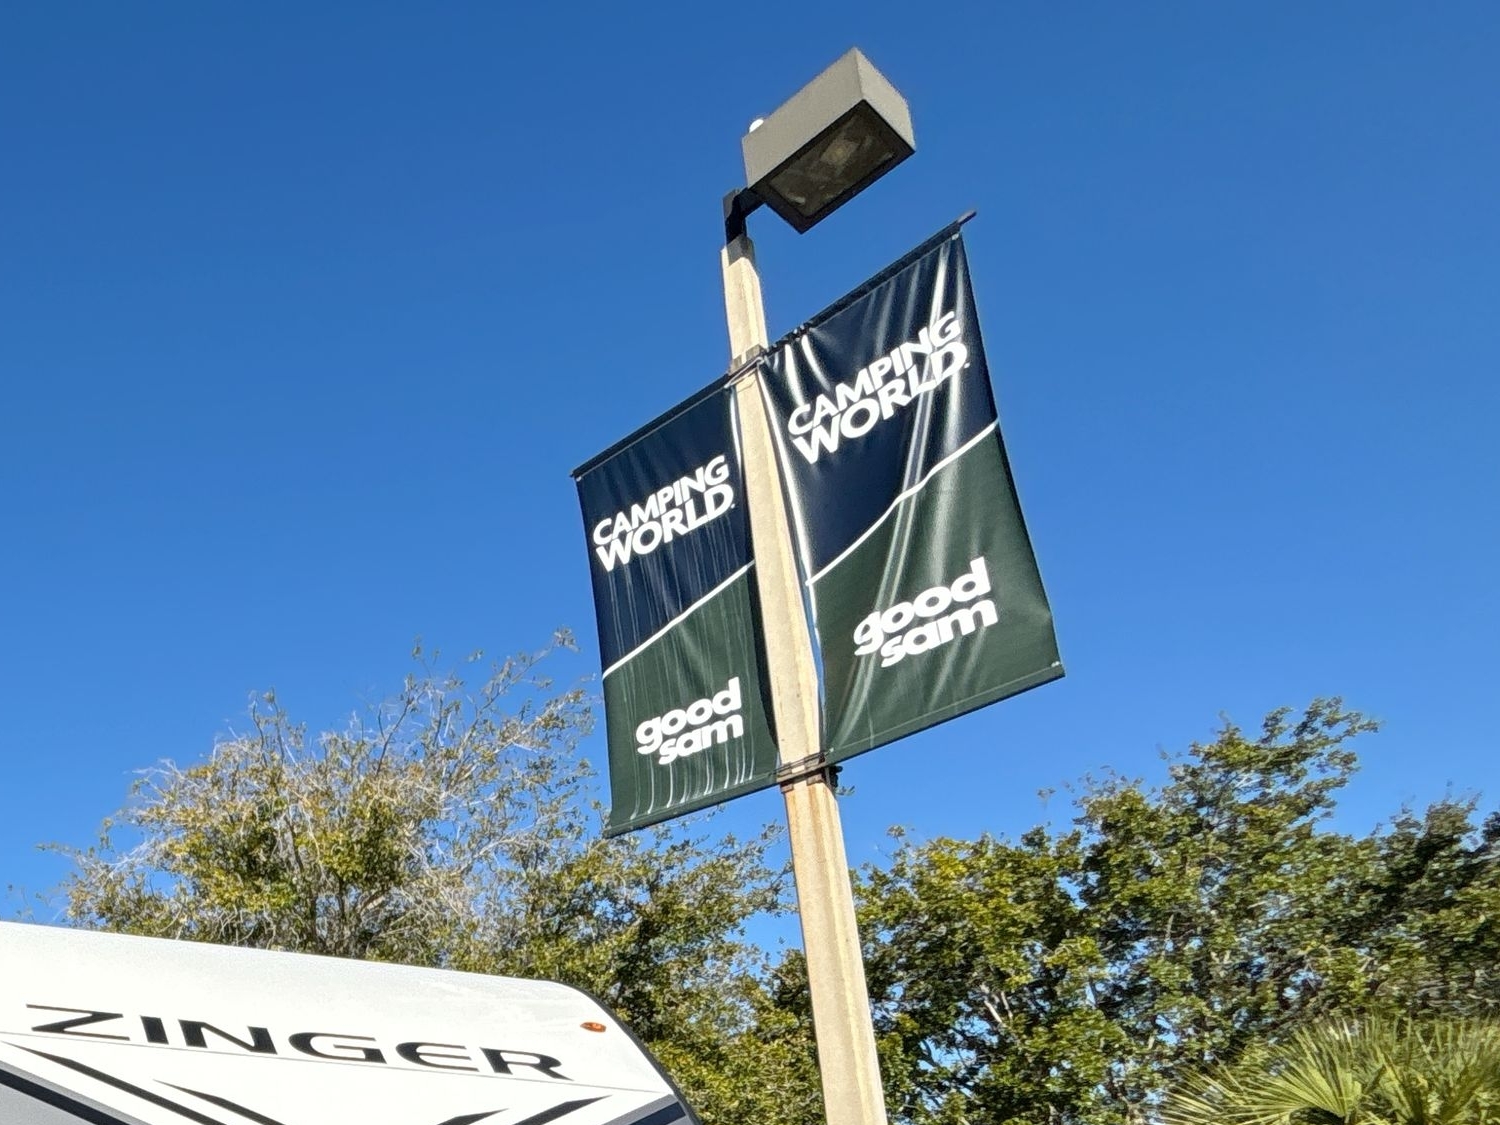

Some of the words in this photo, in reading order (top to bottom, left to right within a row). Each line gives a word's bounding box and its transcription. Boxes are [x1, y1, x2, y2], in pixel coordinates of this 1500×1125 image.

[788, 311, 961, 435] CAMPING
[792, 342, 968, 464] WORLD
[593, 455, 730, 545] CAMPING
[596, 484, 734, 572] WORLD
[854, 556, 991, 656] good
[881, 600, 998, 668] sam
[636, 676, 742, 755] good
[659, 715, 744, 765] sam
[26, 1003, 574, 1081] ZINGER
